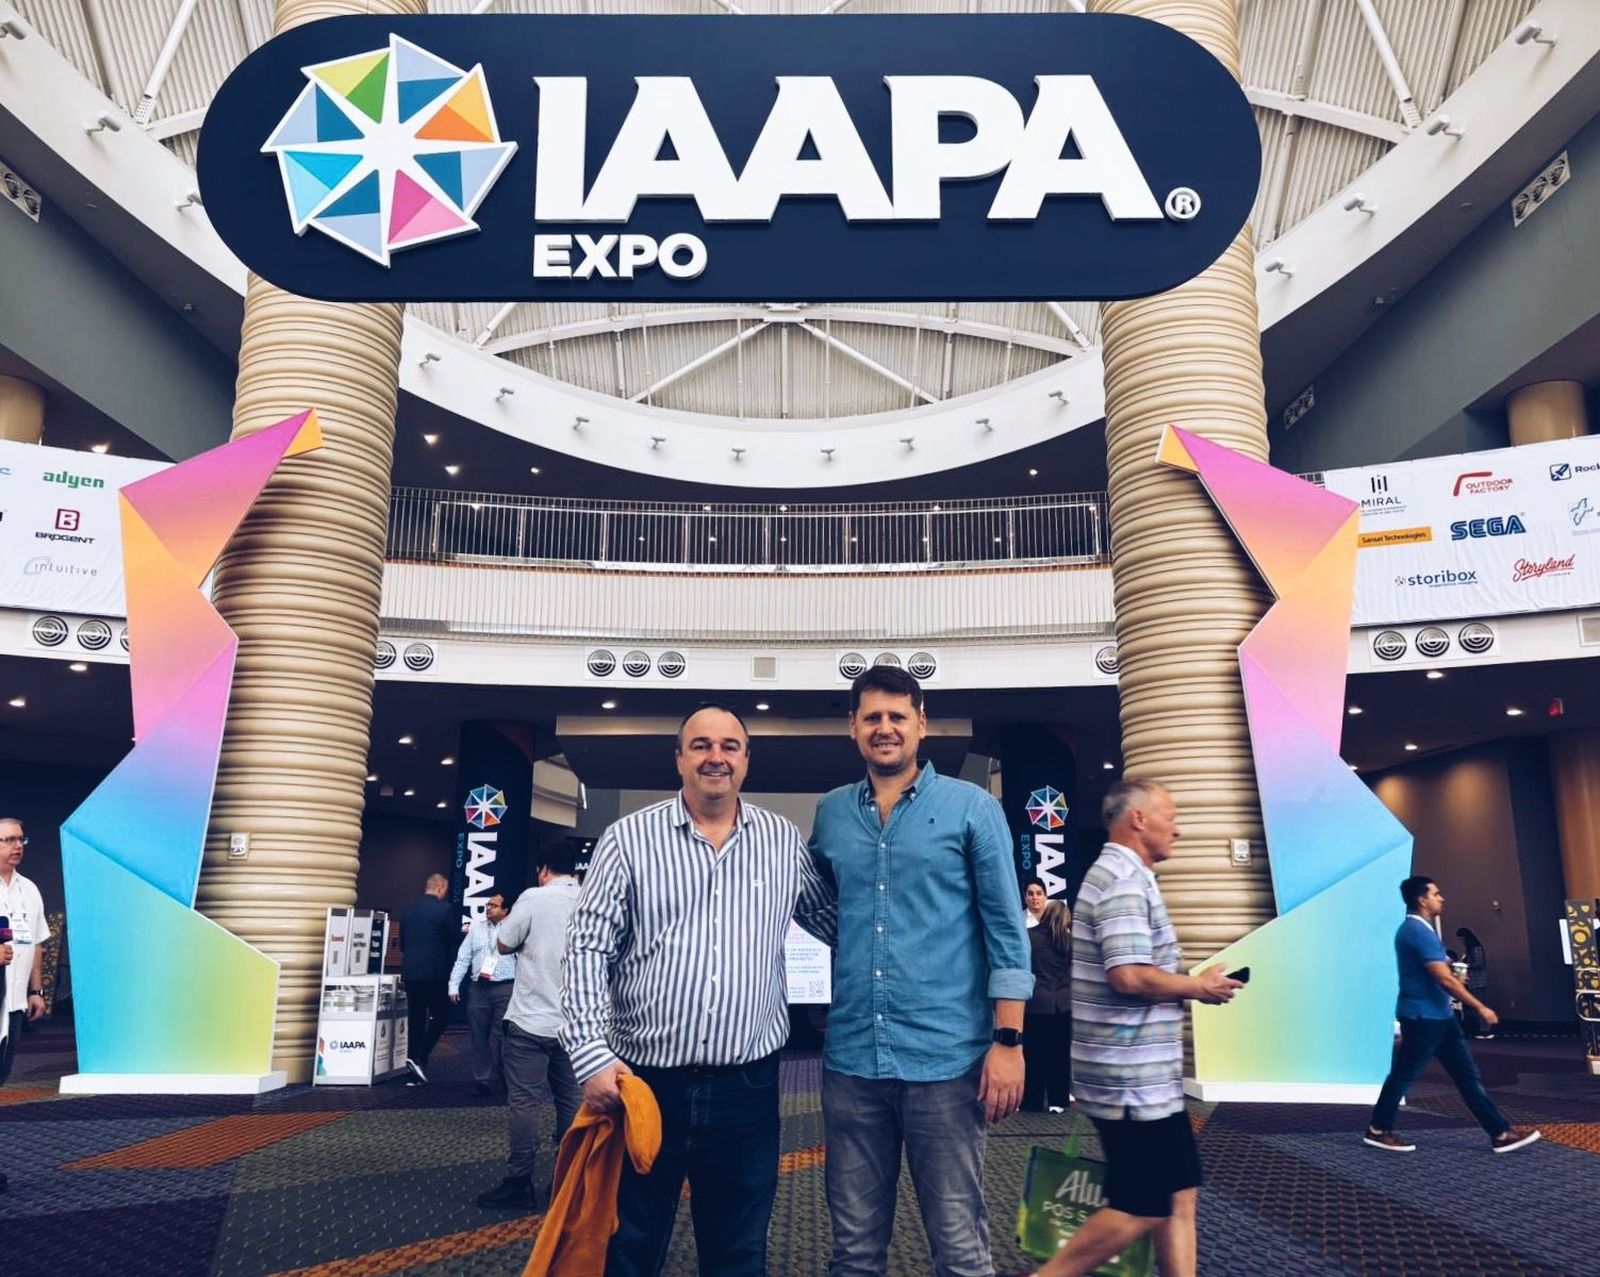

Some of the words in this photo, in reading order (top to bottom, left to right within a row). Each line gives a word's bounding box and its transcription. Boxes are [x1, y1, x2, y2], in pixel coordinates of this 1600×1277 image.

[532, 232, 708, 280] EXPO
[43, 471, 104, 488] adyen
[1465, 478, 1513, 490] OUTDOOR
[1469, 485, 1510, 495] FACTORY
[1361, 496, 1402, 507] MIRAL
[1450, 515, 1526, 541] SEGA
[1408, 570, 1476, 586] storibox
[1513, 553, 1575, 582] Storyland
[1021, 834, 1032, 870] EXPO
[462, 832, 498, 927] IAAP
[1034, 833, 1068, 905] IAA
[339, 1040, 367, 1049] IAAPA
